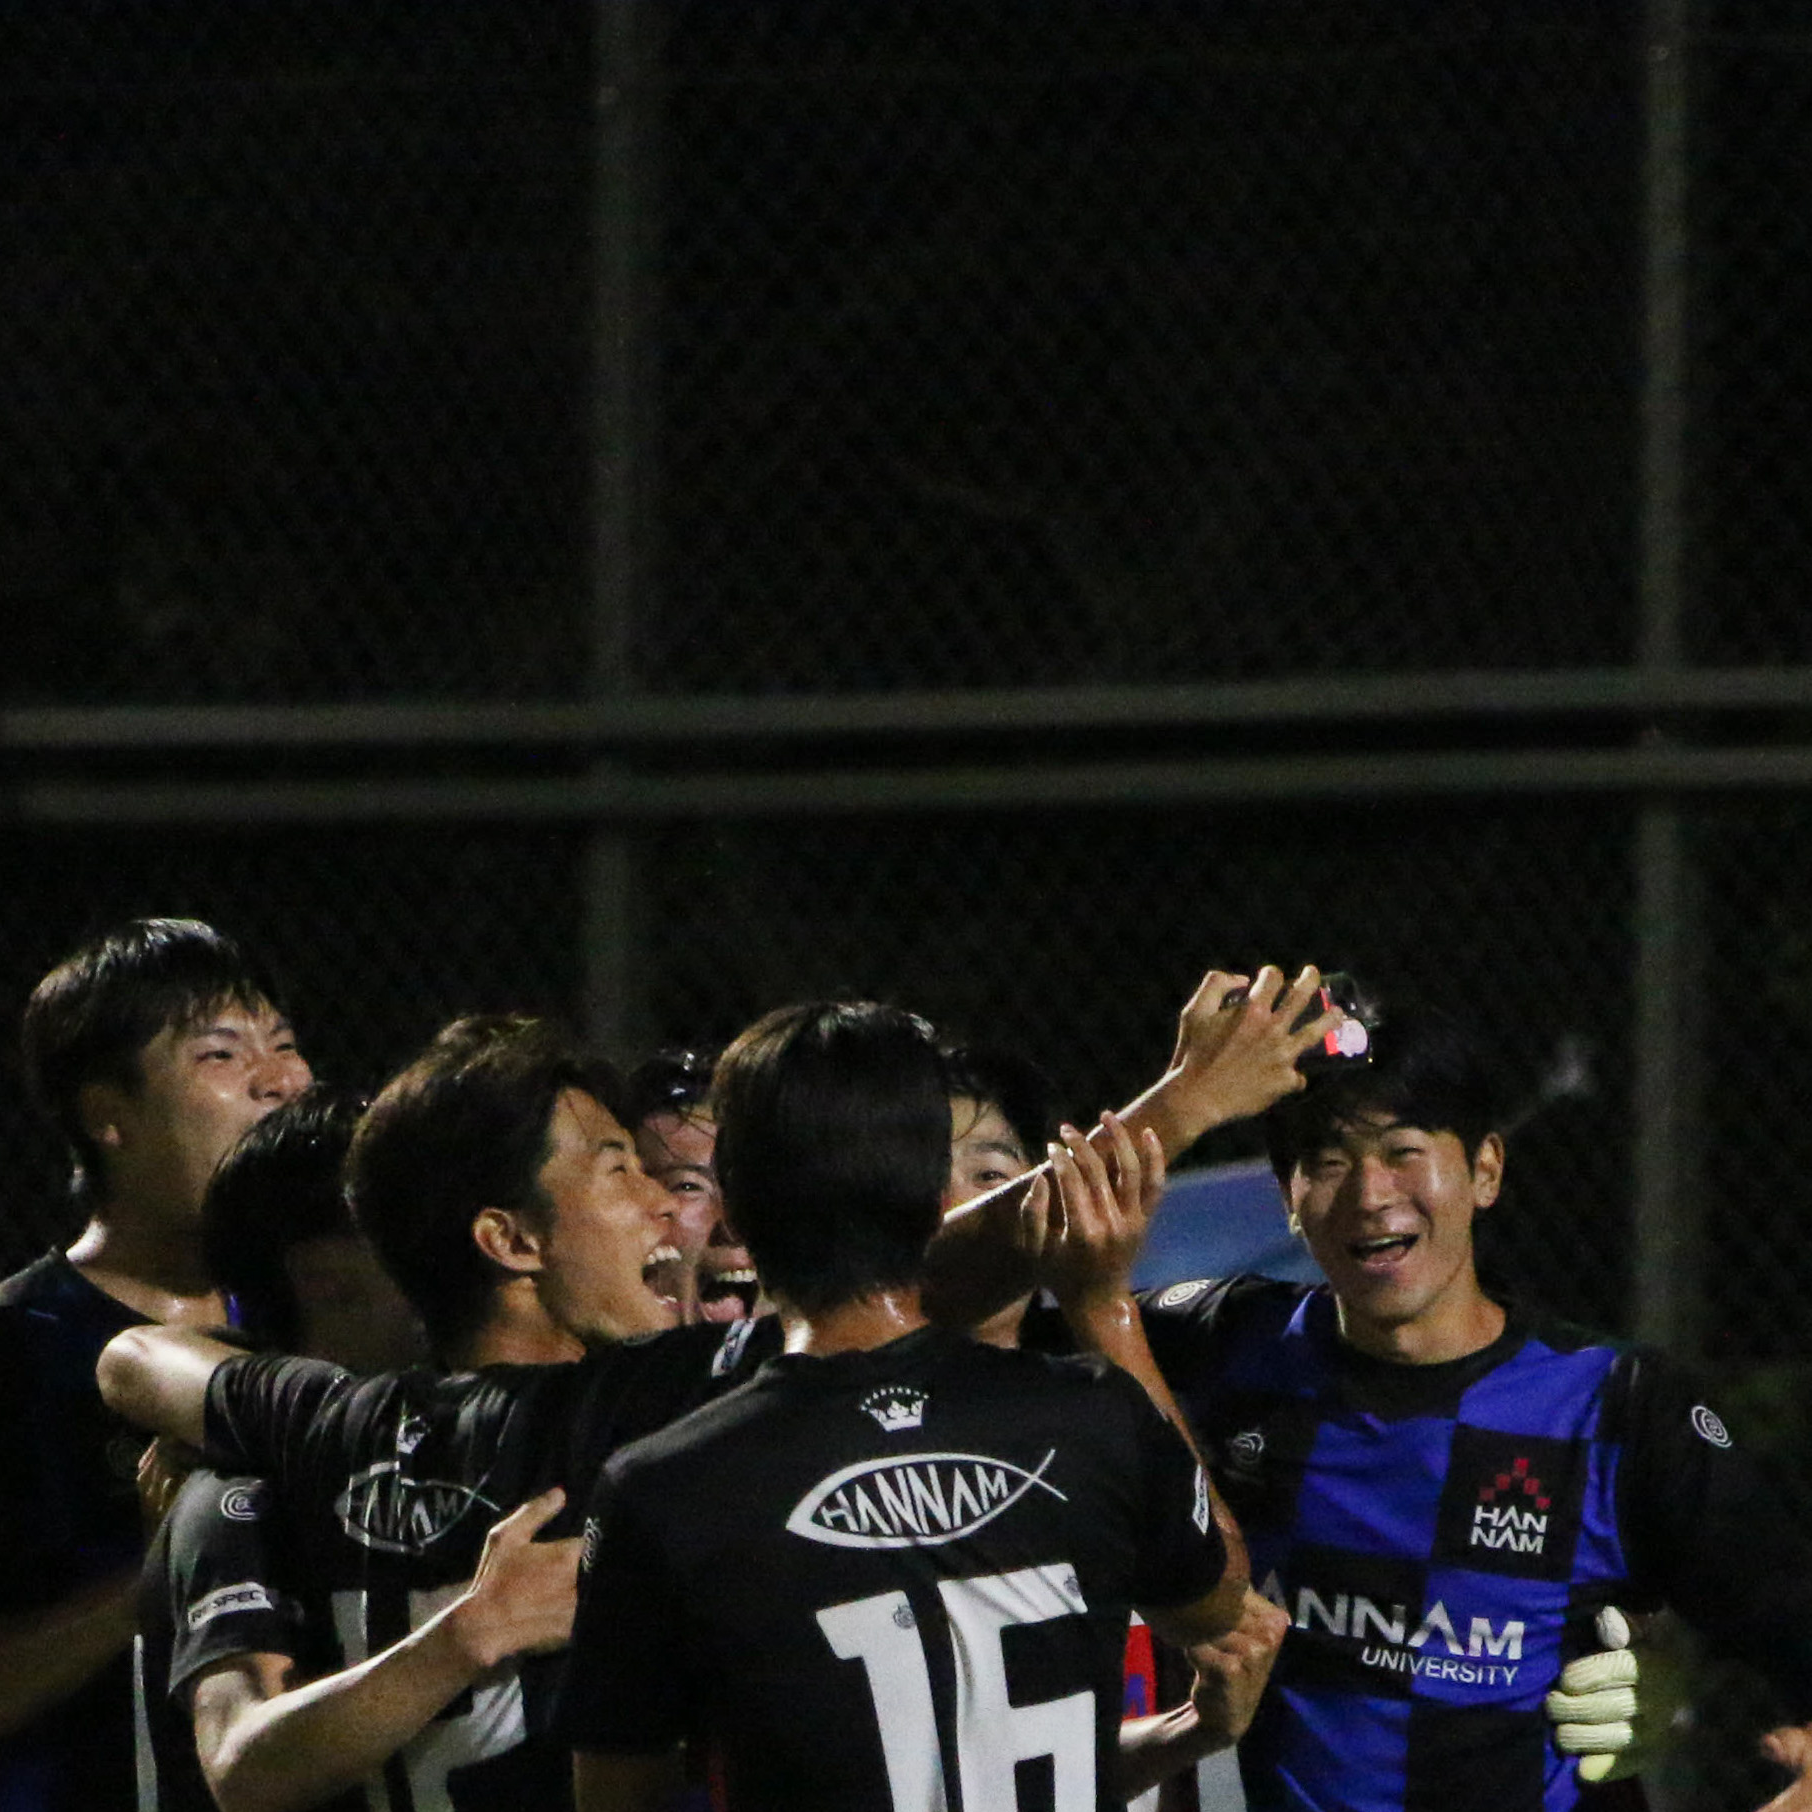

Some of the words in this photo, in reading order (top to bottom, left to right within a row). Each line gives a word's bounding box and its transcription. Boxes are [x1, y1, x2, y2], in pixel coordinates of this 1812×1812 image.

[821, 1463, 1009, 1535] HANNAM
[1474, 1505, 1548, 1534] HAN
[1470, 1525, 1545, 1555] NAM
[1258, 1569, 1525, 1660] ANNAM
[1361, 1646, 1519, 1686] UNIVERSITY
